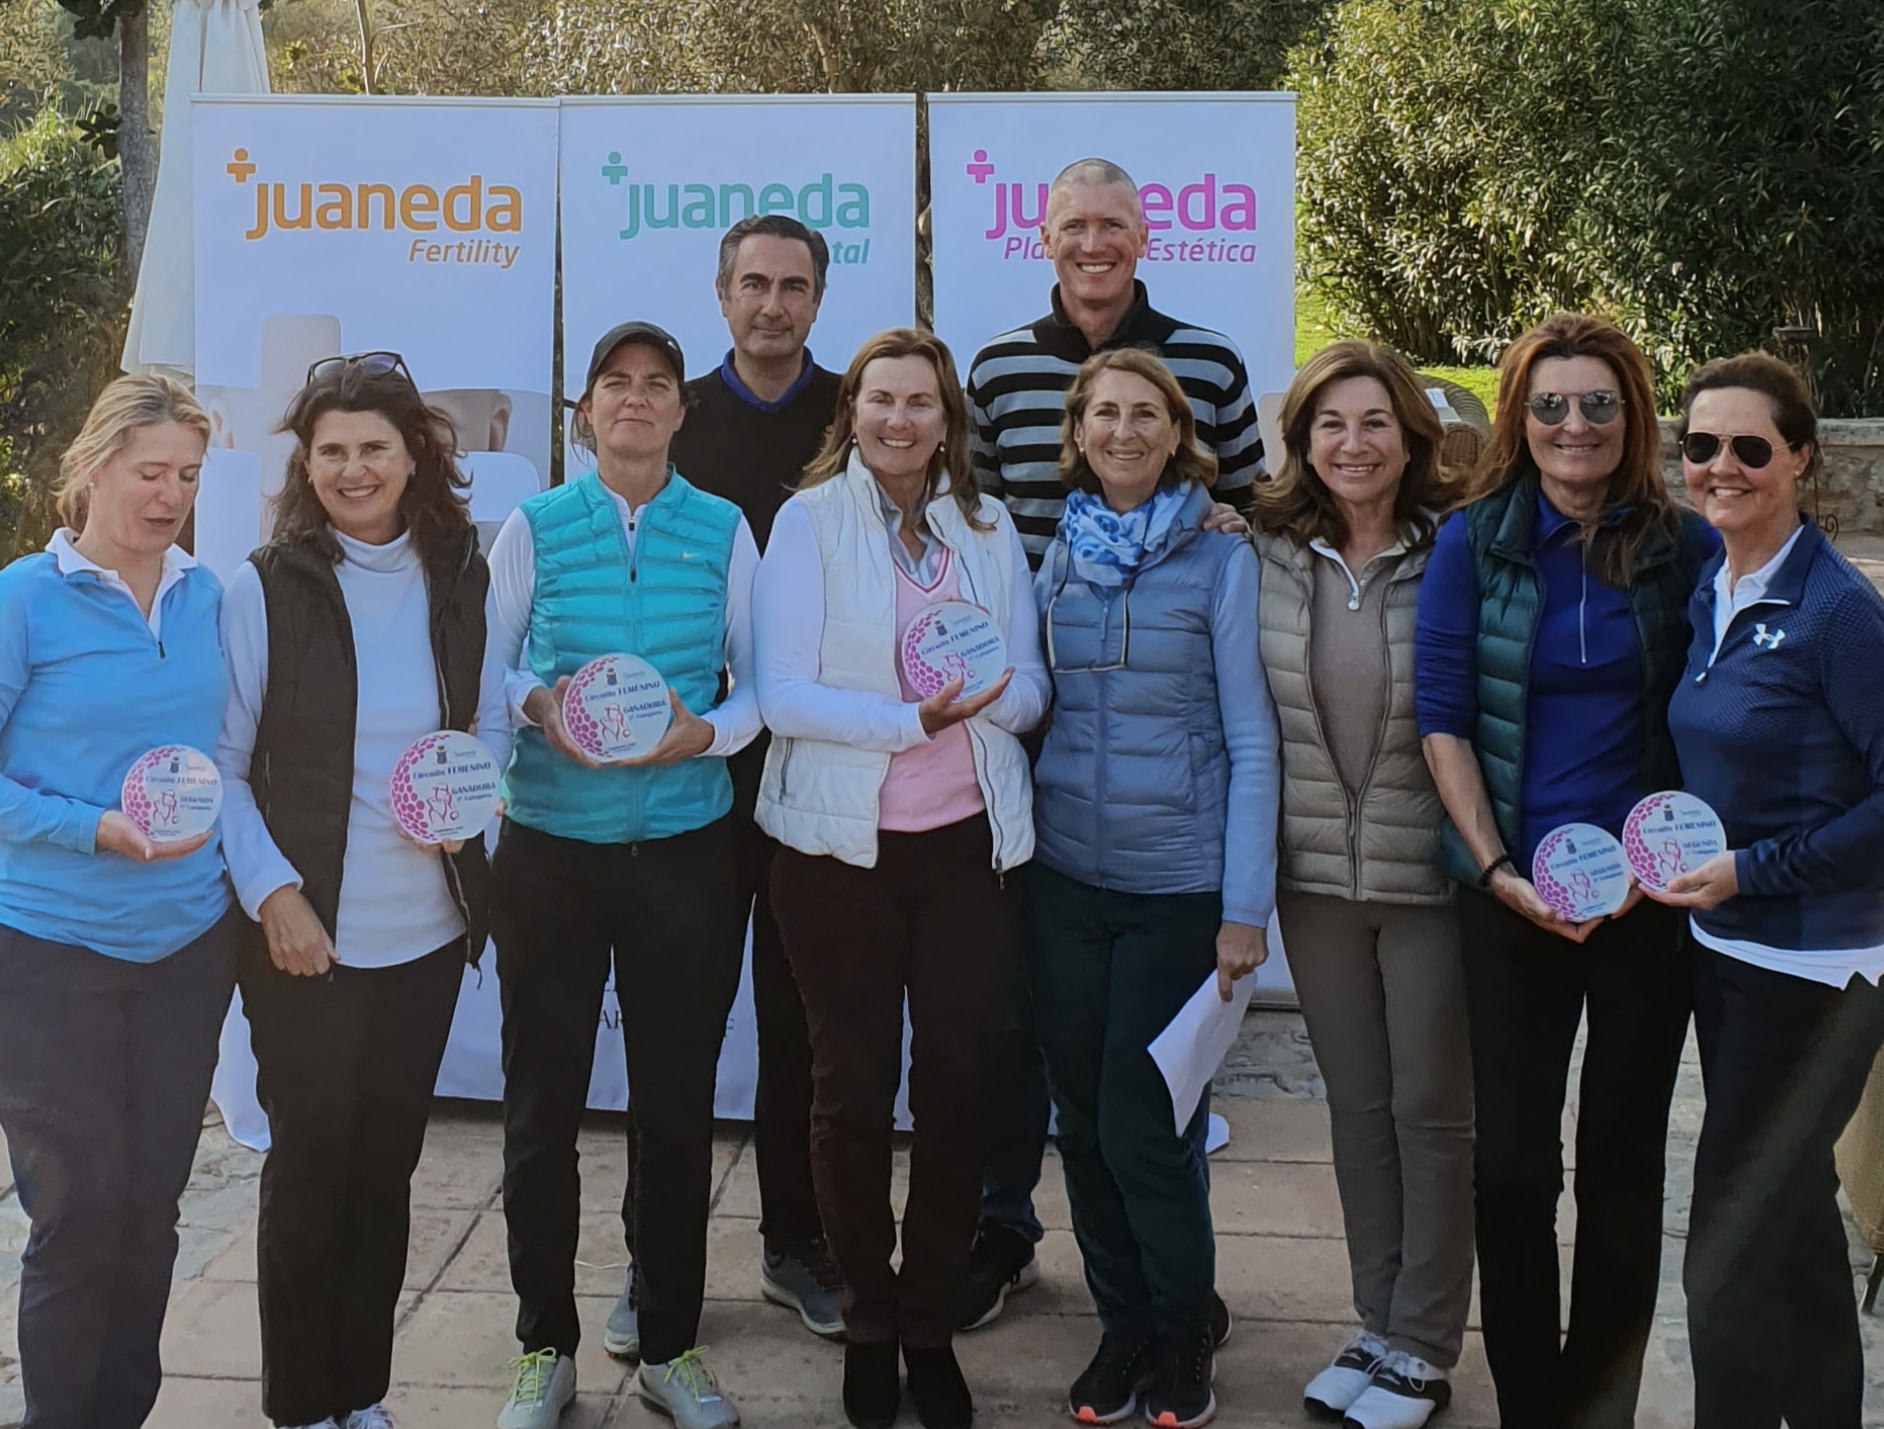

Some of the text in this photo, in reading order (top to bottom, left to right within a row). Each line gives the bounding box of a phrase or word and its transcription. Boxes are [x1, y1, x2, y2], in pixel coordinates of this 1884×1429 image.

[245, 175, 522, 240] juaneda
[619, 173, 870, 240] juaneda
[985, 173, 1257, 239] jueda
[408, 239, 520, 269] Fertility
[1146, 237, 1257, 263] Estética
[950, 620, 989, 643] FEMENINO
[960, 635, 1000, 657] GANADORA
[618, 680, 660, 696] FEMENINO
[622, 699, 666, 714] GANADORA
[448, 761, 491, 775] FEMENINO
[451, 781, 496, 795] GANADORA
[1674, 820, 1716, 831] FEMENINO
[1578, 845, 1617, 862] FEMENINO
